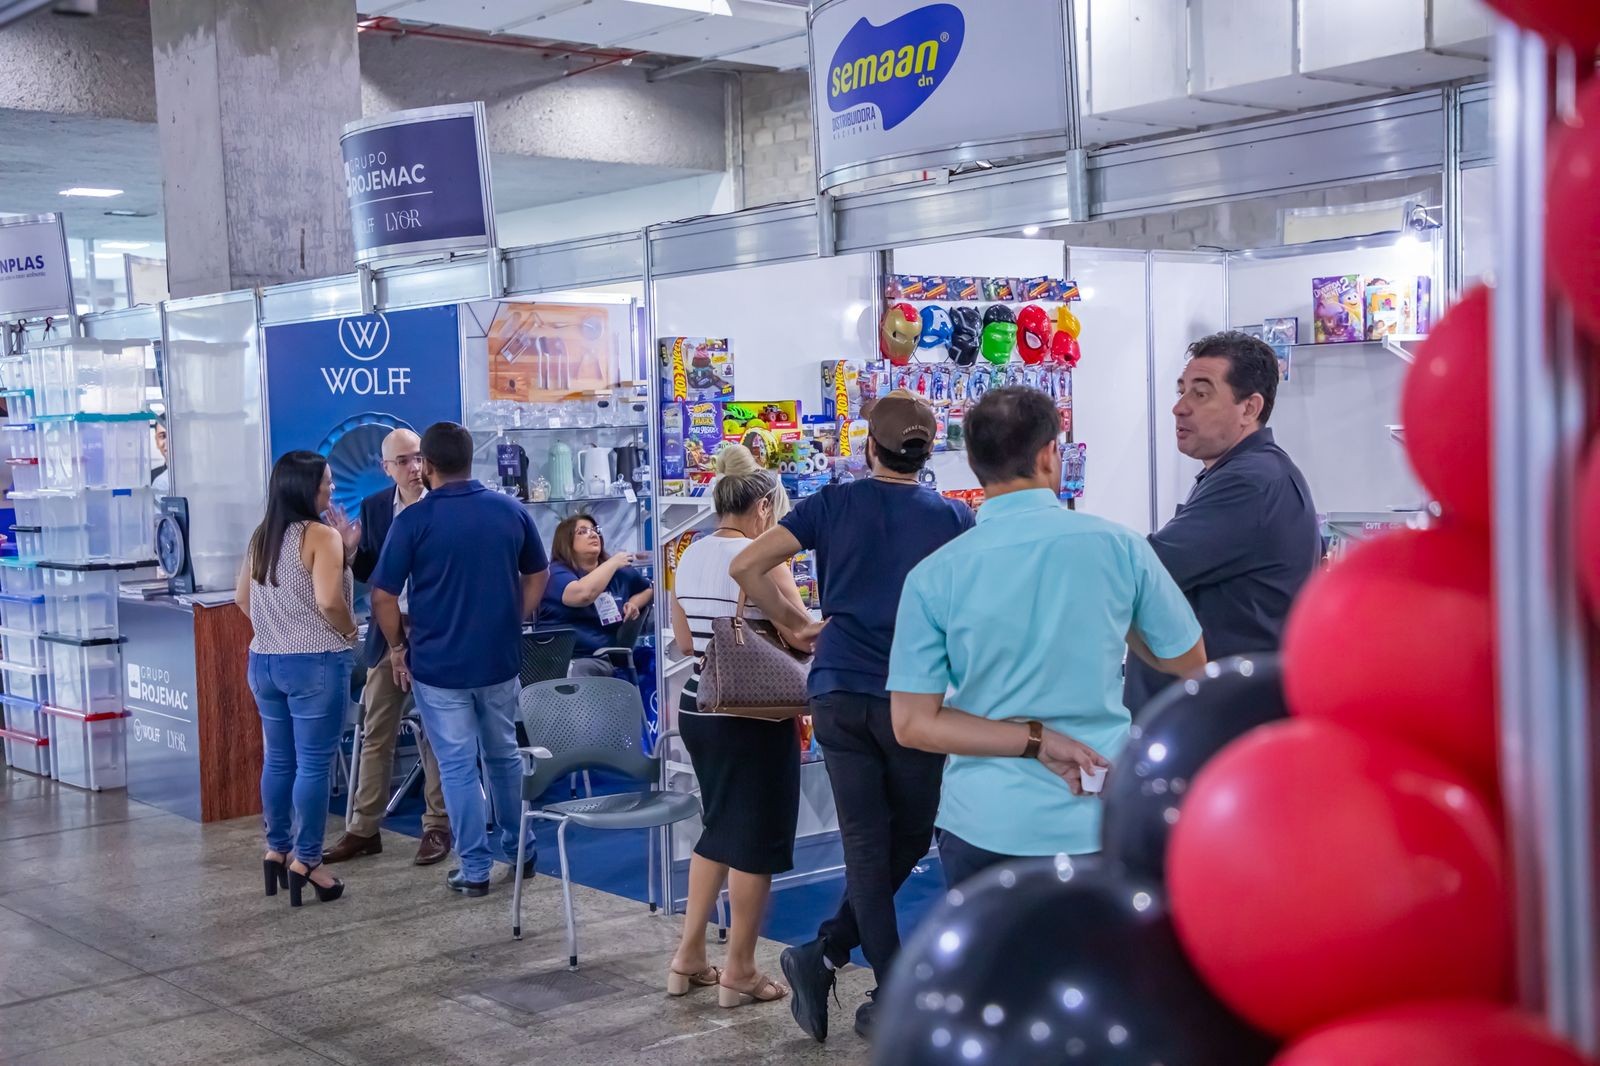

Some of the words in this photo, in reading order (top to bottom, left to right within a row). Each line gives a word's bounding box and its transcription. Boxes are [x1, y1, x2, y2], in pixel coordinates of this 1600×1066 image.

[831, 39, 939, 97] semaan
[918, 74, 934, 87] dn
[832, 106, 876, 131] DISTRIBUIDORA
[349, 151, 387, 173] GRUPO
[352, 163, 426, 195] ROJEMAC
[385, 209, 422, 231] LYOR
[320, 367, 411, 395] WOLFF
[140, 666, 170, 683] GRUPO
[141, 682, 189, 711] ROJEMAC
